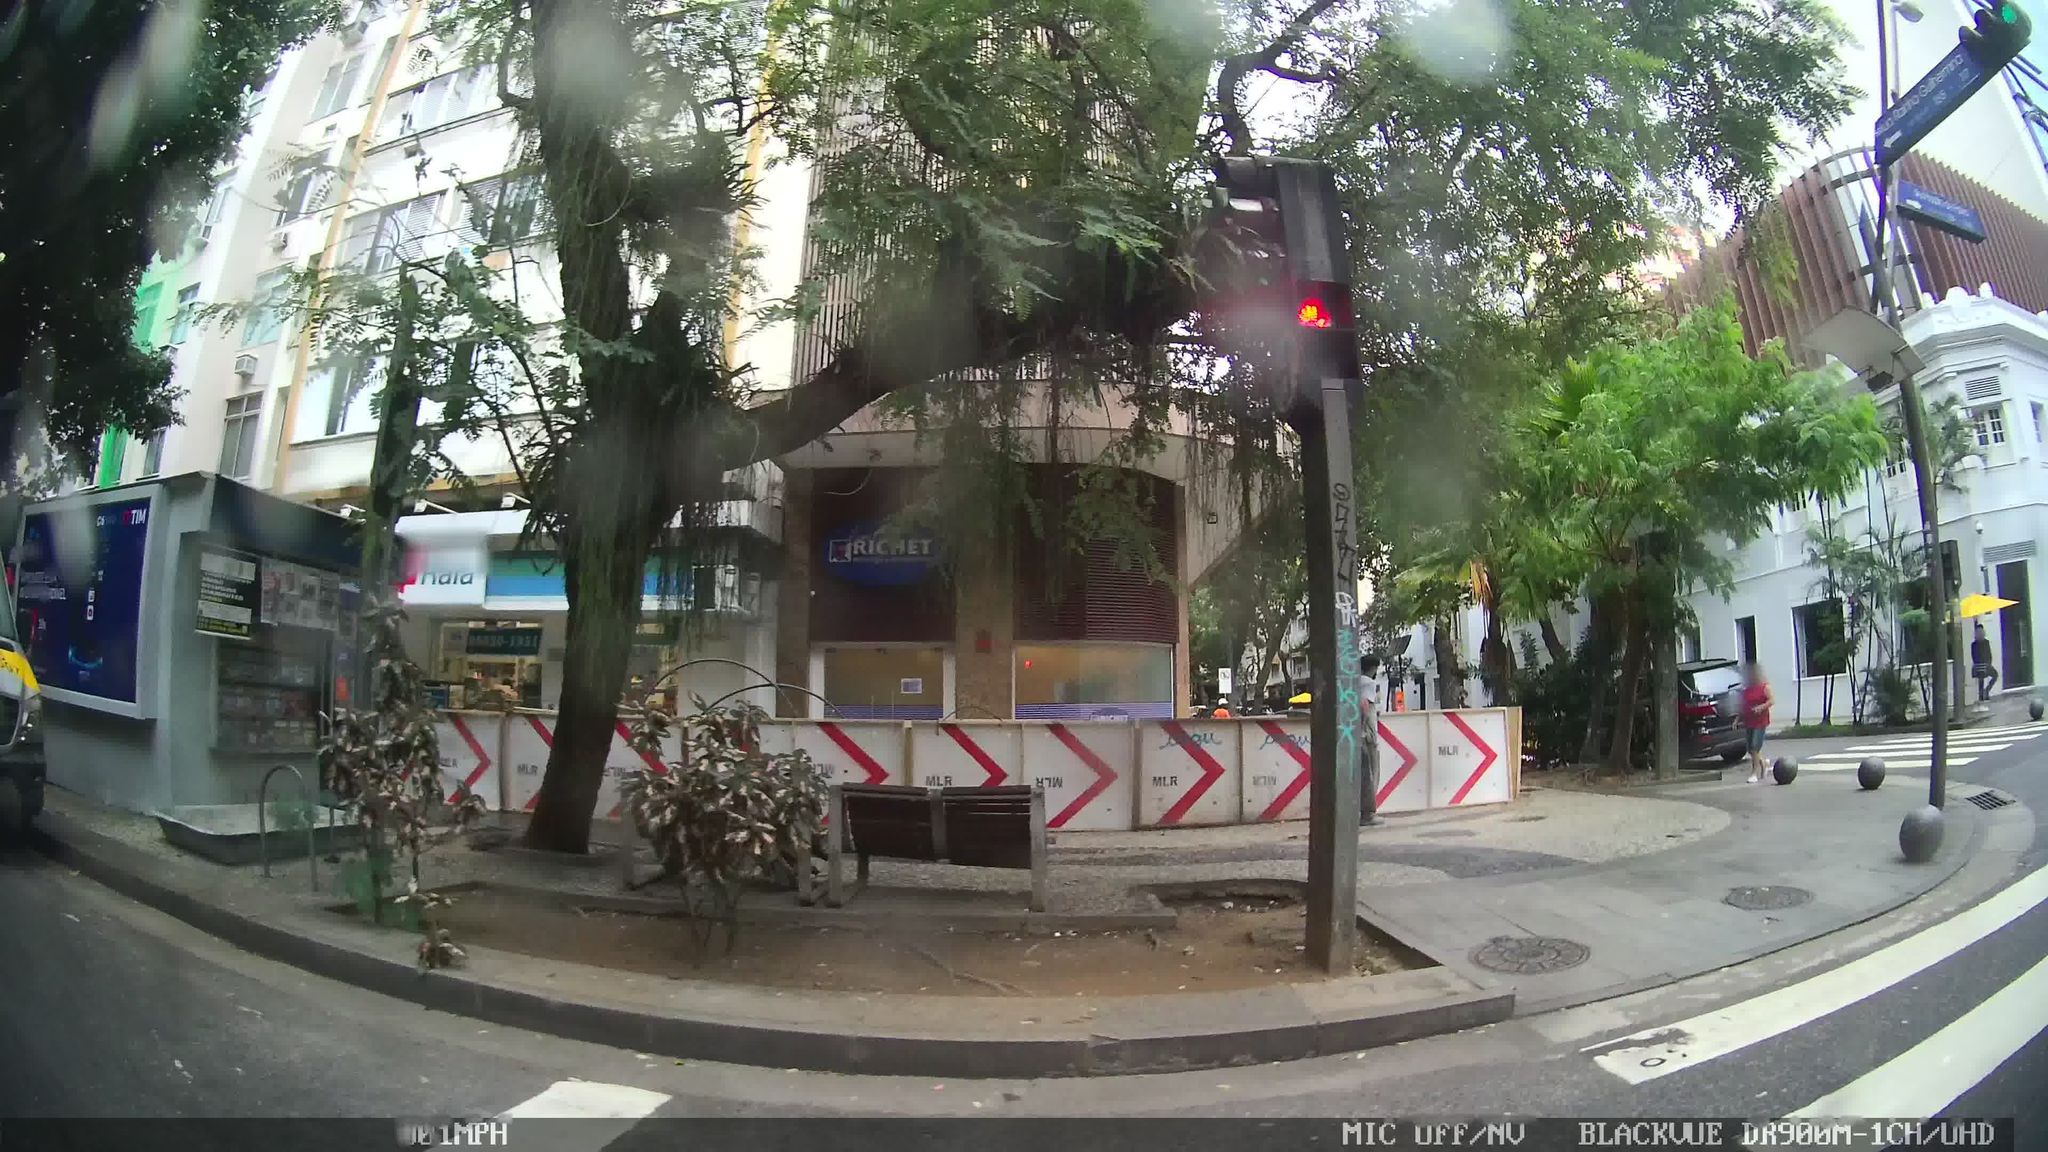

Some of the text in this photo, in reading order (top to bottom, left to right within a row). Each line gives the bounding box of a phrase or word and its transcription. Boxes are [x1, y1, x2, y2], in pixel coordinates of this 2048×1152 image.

[852, 539, 932, 555] RICHET
[517, 764, 538, 776] MLR
[925, 775, 953, 787] MLR
[1152, 775, 1178, 787] MLR
